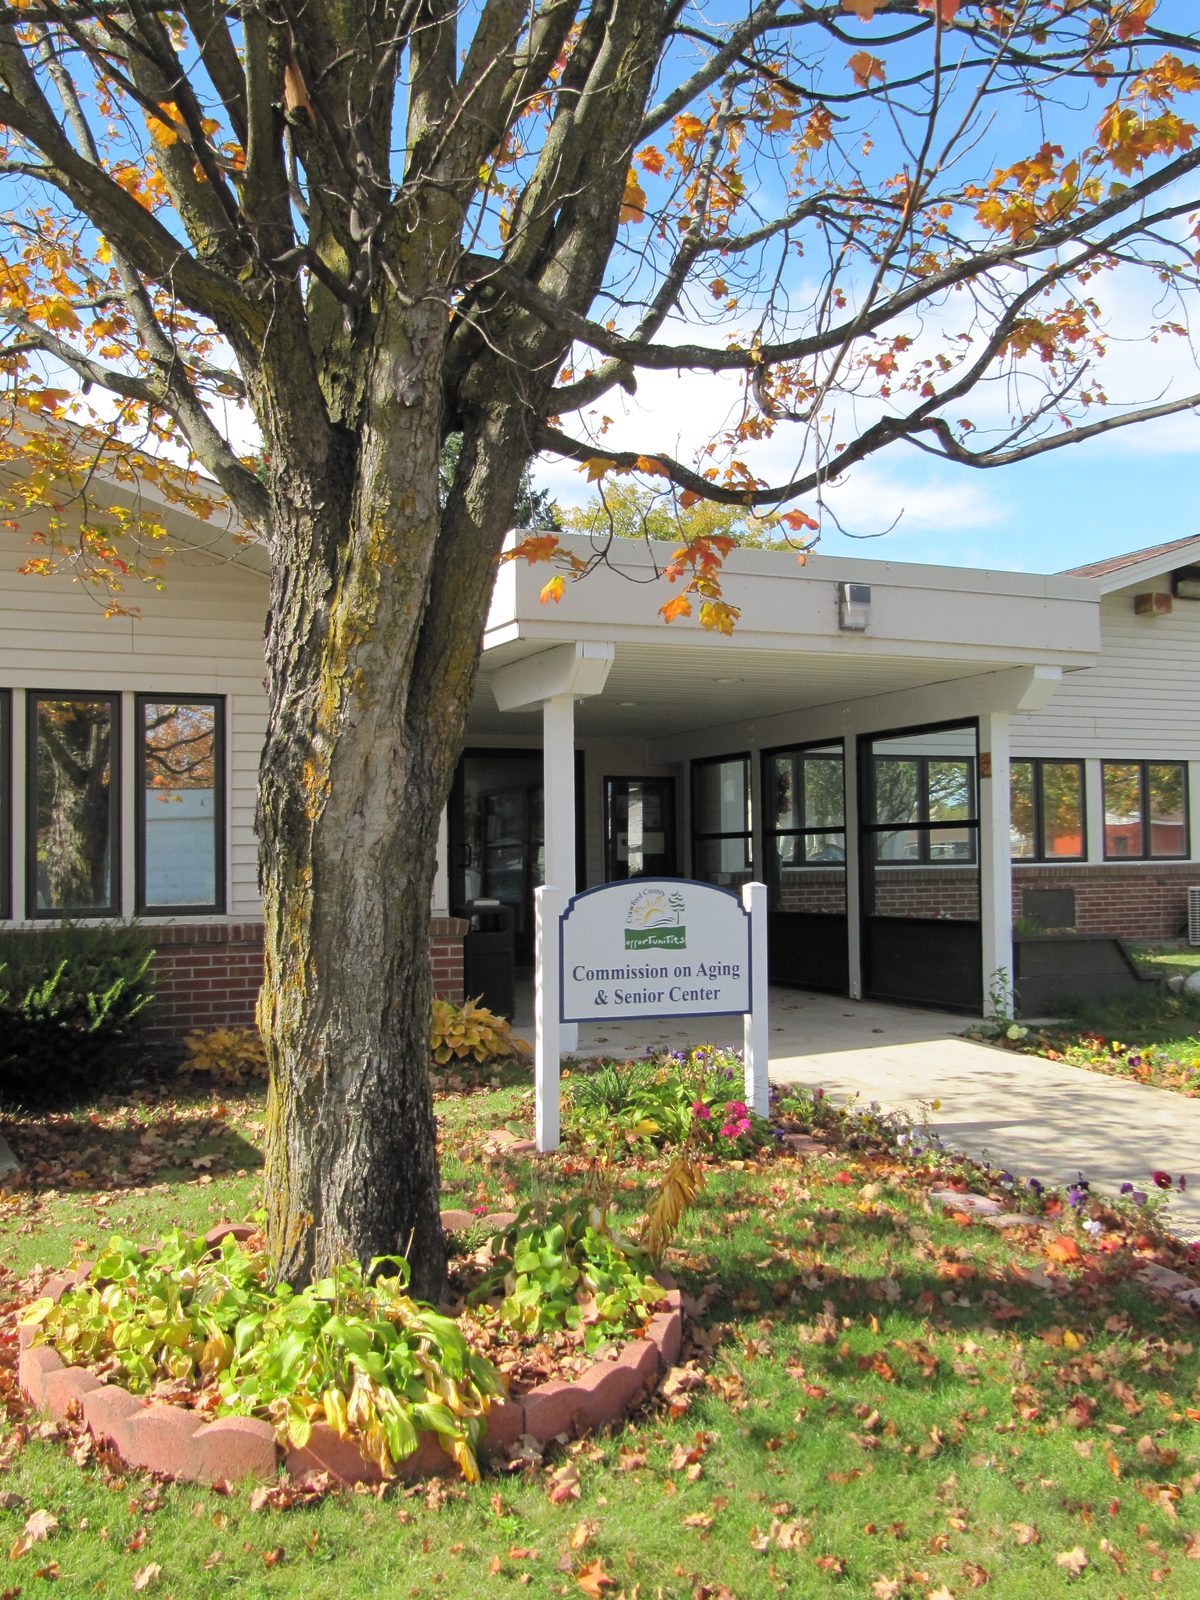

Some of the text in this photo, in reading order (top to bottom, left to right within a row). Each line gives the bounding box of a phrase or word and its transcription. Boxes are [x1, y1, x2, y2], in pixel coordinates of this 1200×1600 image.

[626, 888, 666, 924] Crawford County
[572, 961, 741, 981] Commission on Aging
[594, 985, 721, 1006] & Senior Center
